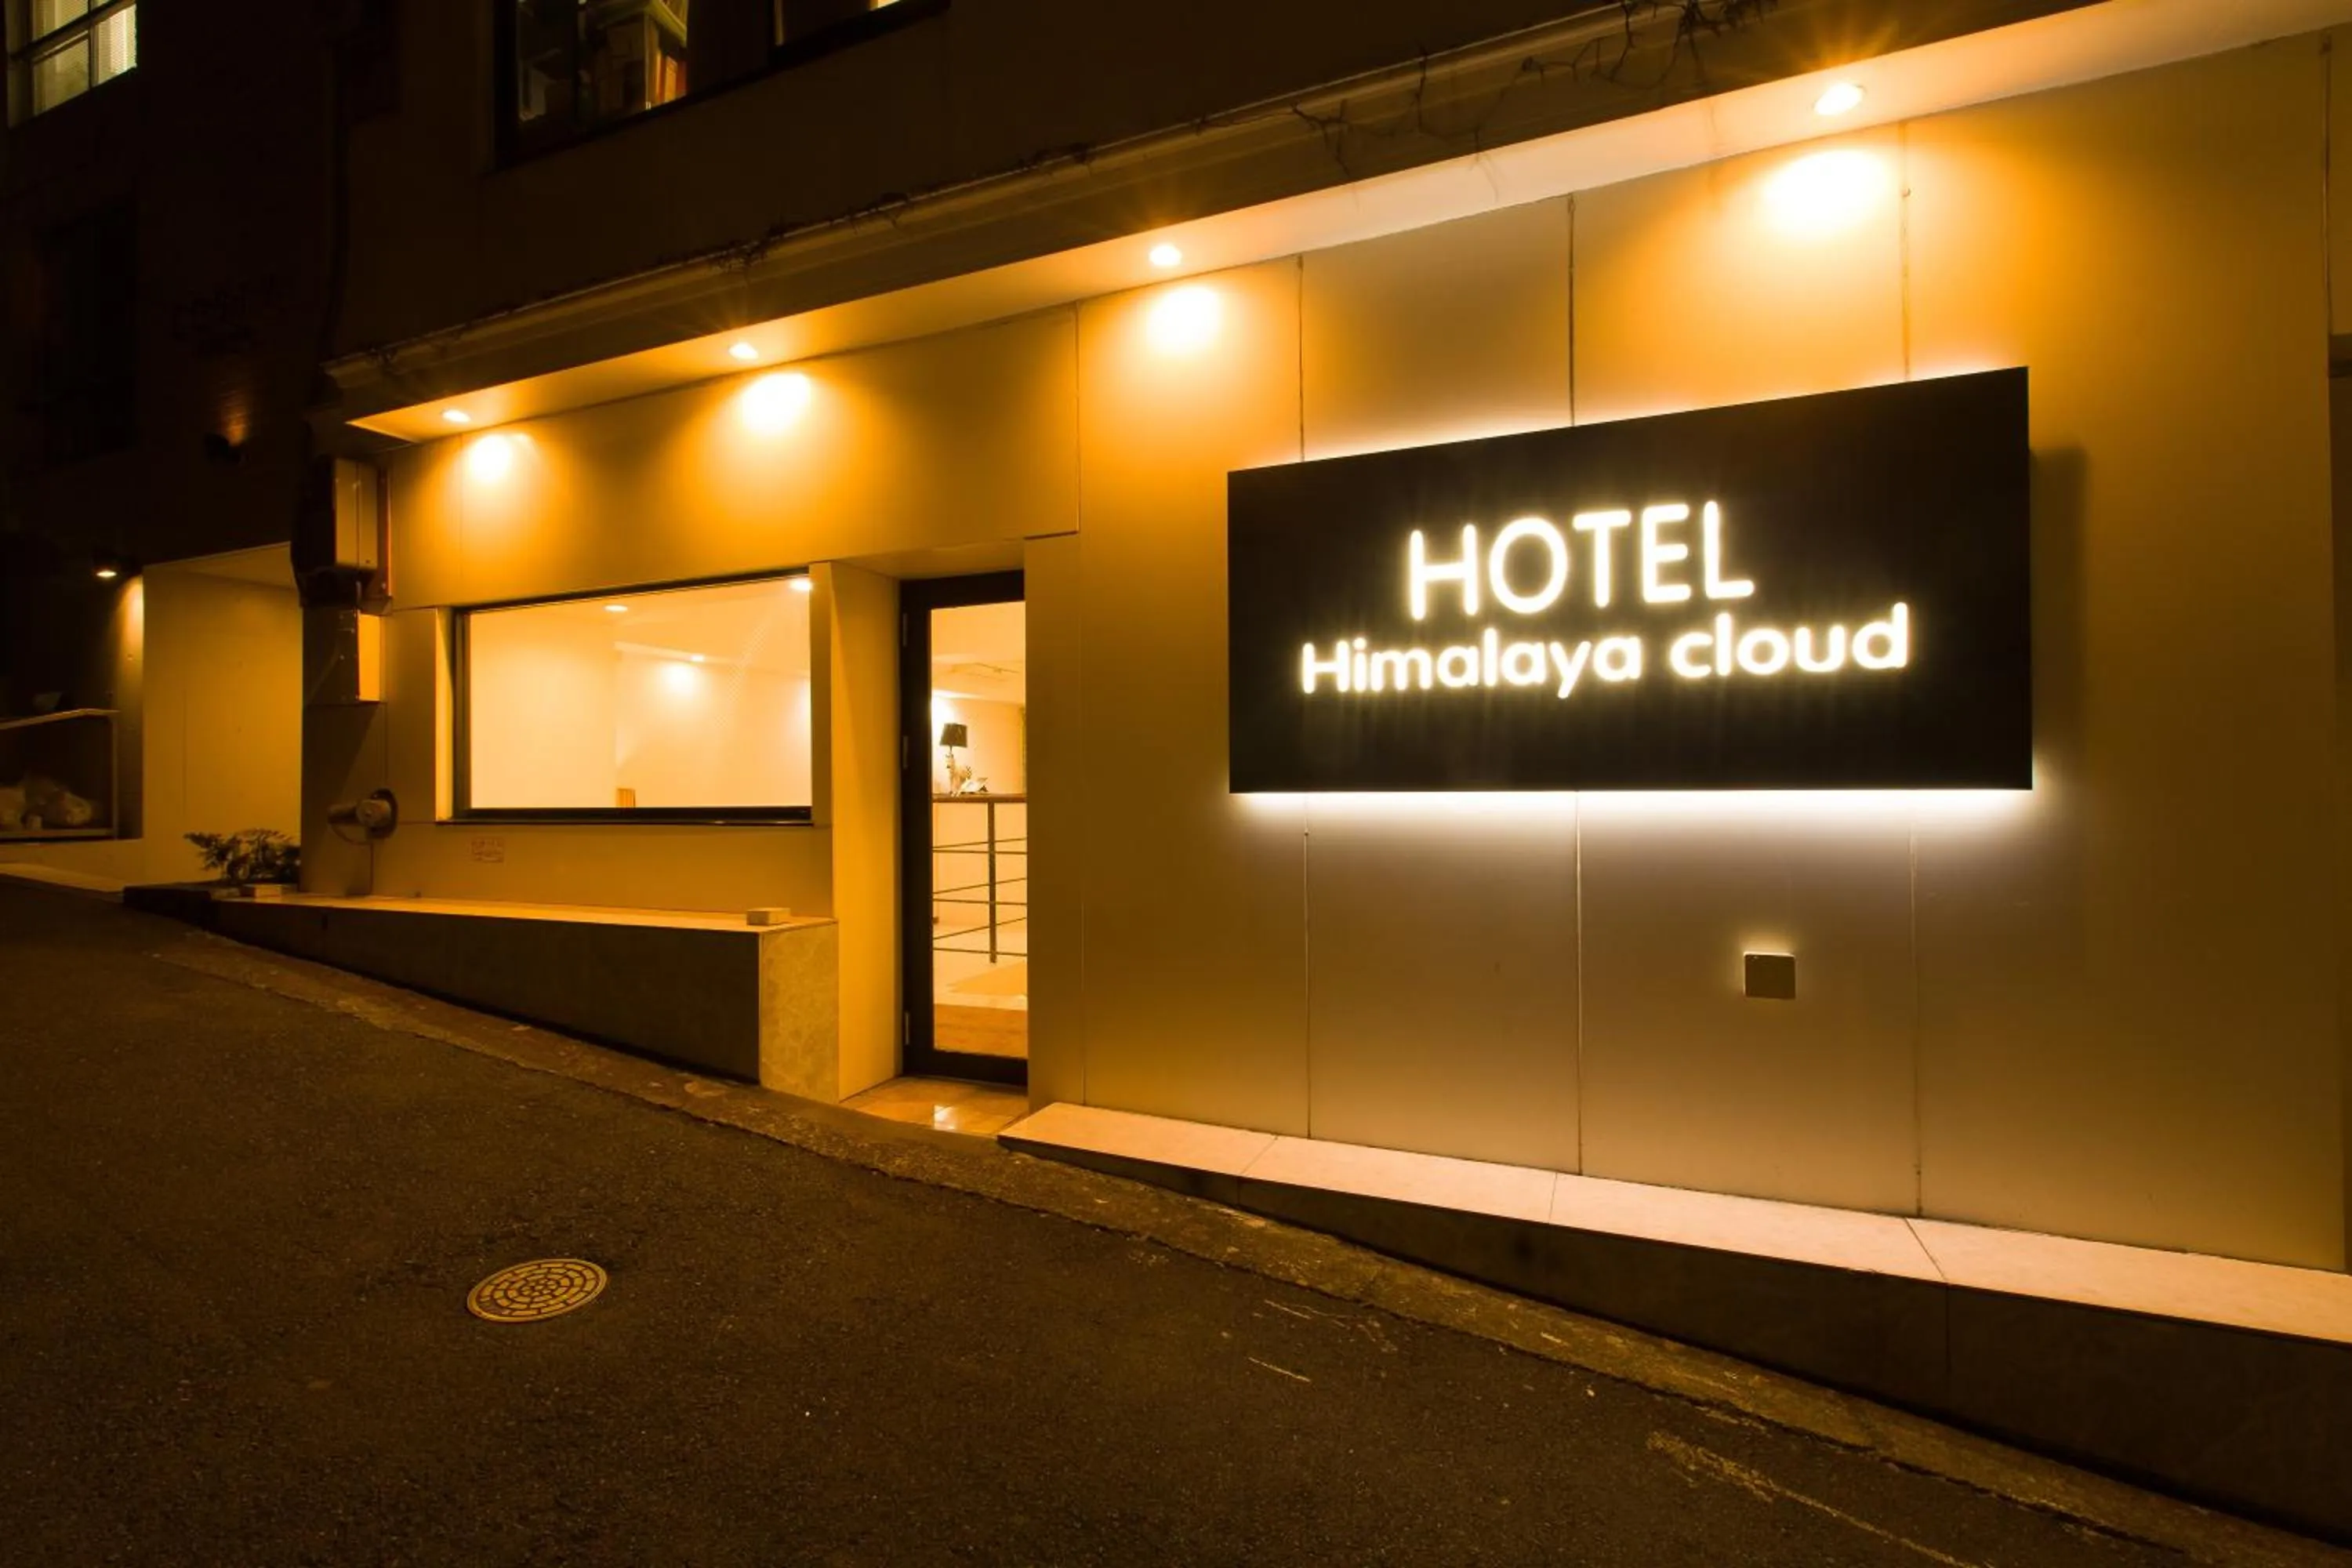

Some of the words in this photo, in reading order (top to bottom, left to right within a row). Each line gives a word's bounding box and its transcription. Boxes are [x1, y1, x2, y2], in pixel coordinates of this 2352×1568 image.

[1409, 500, 1755, 620] HOTEL
[1301, 627, 1643, 699] Himalaya
[1668, 602, 1909, 678] cloud
